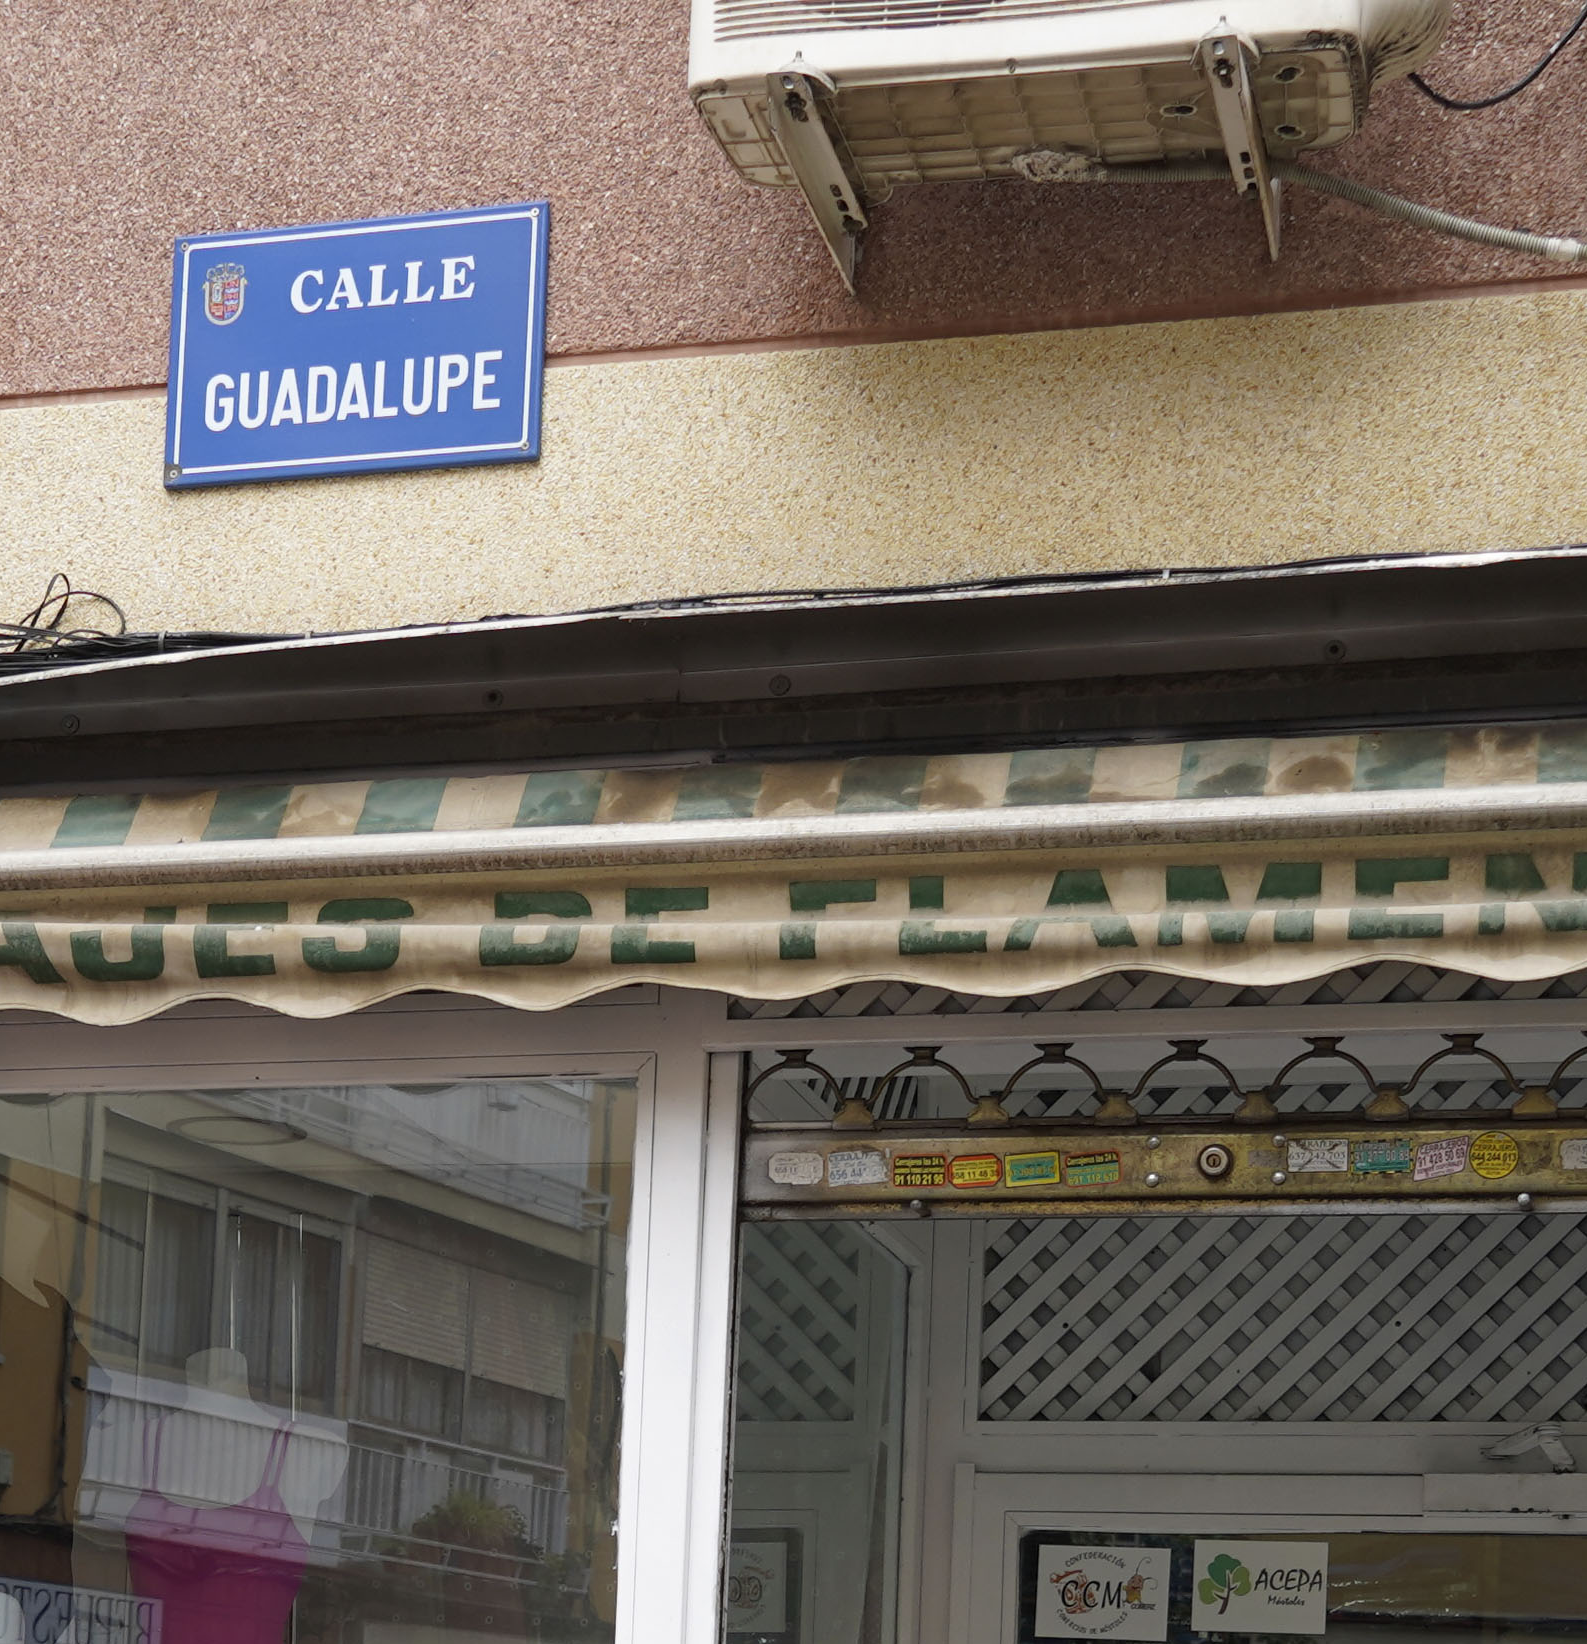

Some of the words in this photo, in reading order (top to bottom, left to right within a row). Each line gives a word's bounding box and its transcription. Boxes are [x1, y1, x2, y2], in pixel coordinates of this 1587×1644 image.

[290, 255, 476, 314] CALLE
[203, 350, 504, 433] GUADALUPE
[478, 886, 709, 967] DE
[1061, 1580, 1124, 1609] CCM
[1254, 1568, 1322, 1592] ACEPA
